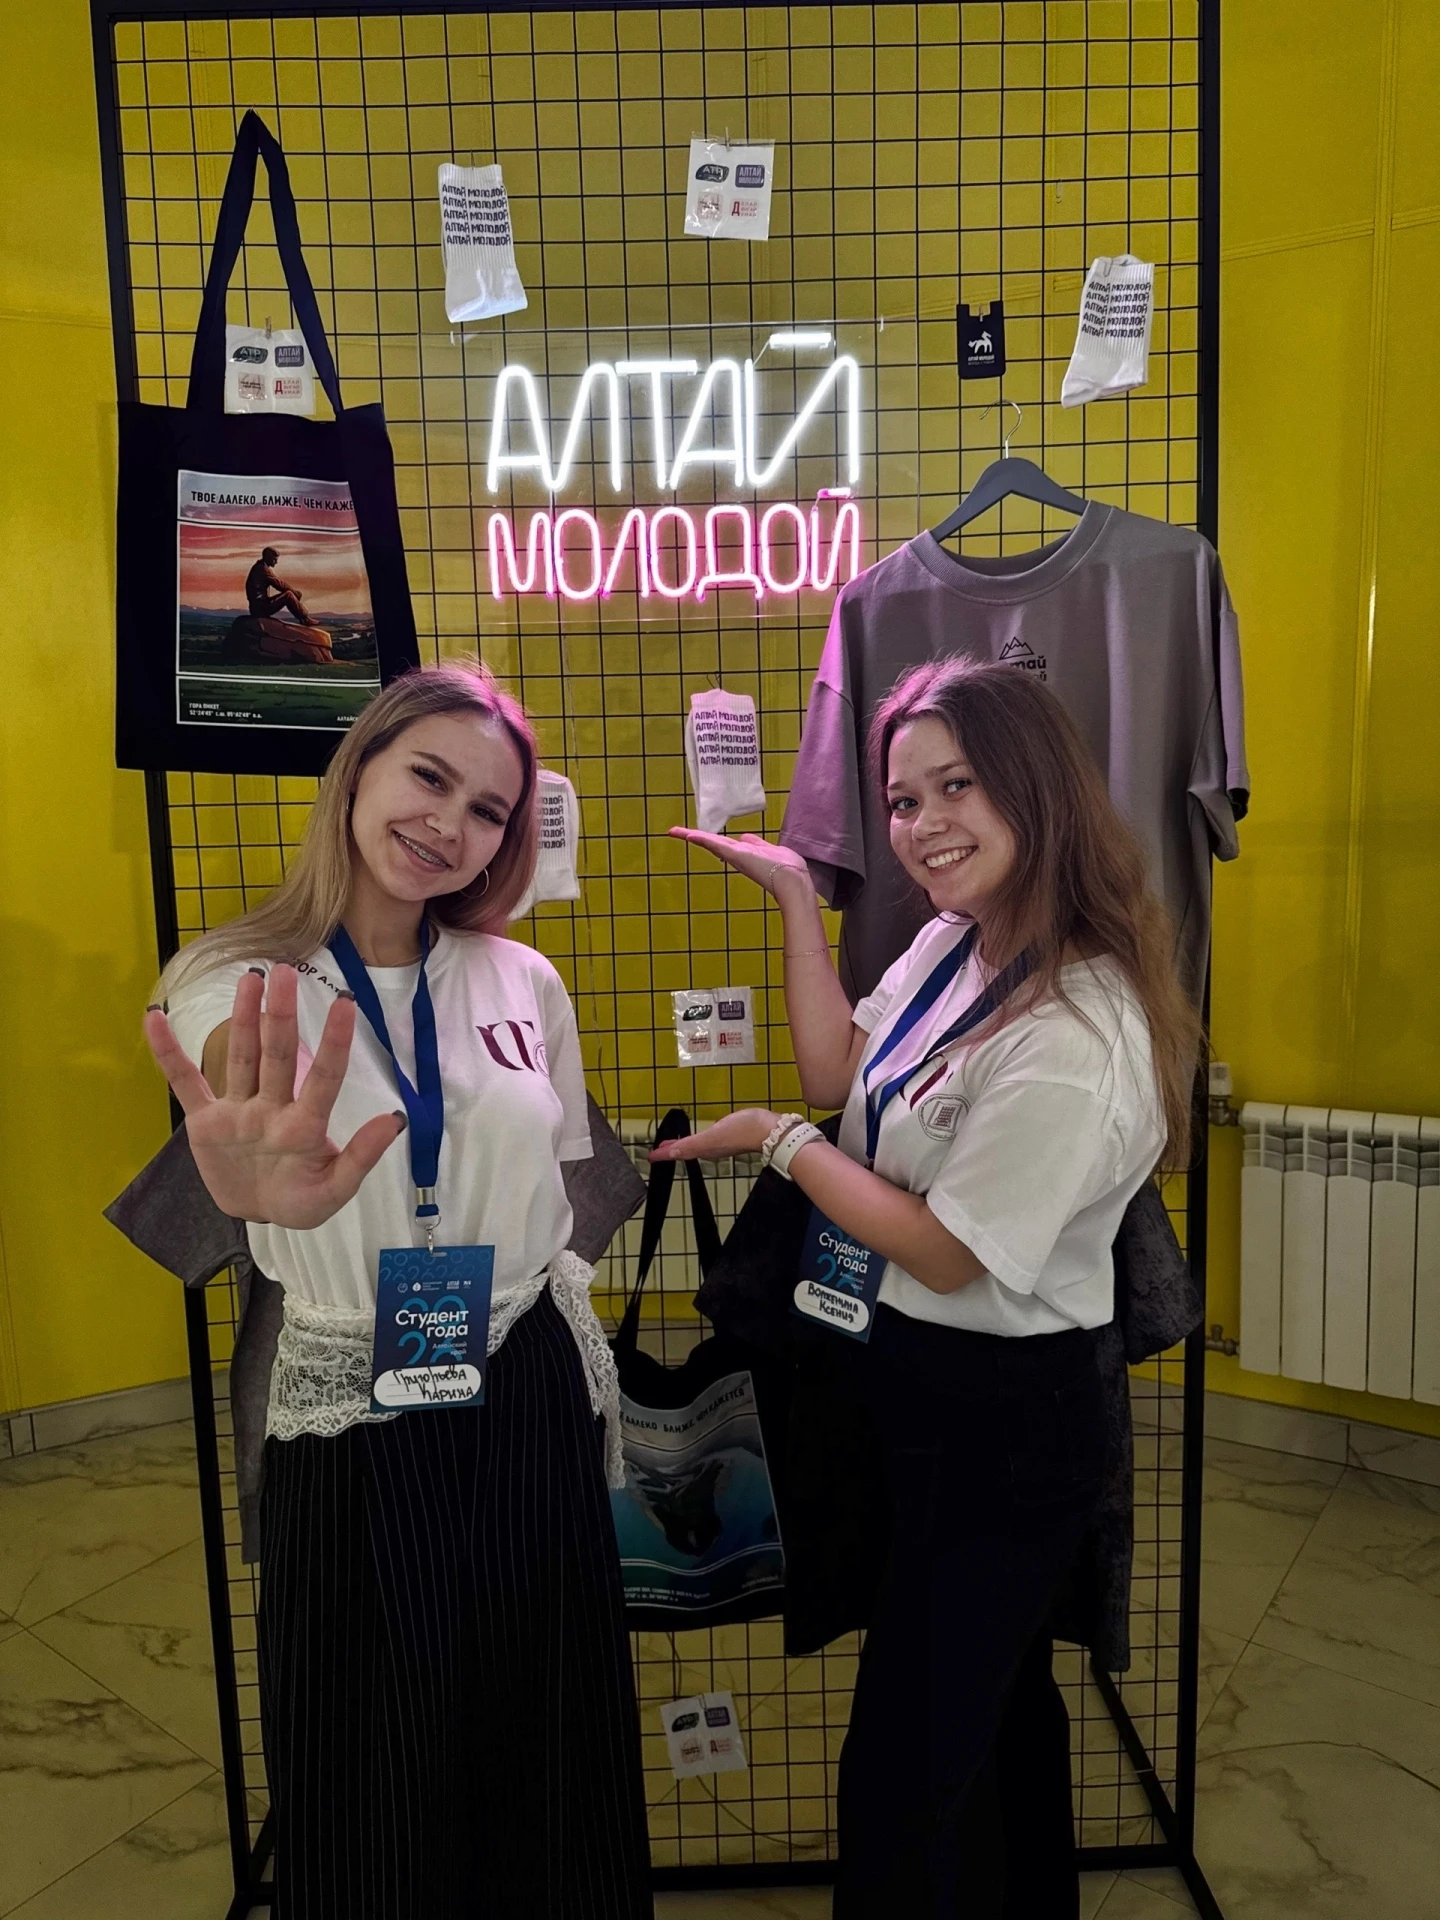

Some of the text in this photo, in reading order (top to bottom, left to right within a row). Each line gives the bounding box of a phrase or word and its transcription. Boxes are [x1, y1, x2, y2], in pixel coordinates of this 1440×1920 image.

[739, 166, 762, 176] АЛТАЙ
[442, 184, 506, 198] АЛТАЙ МОЛОДОЙ
[443, 196, 507, 209] АЛТАЙ МОЛОДОЙ
[444, 209, 508, 221] АЛТАЙ МОЛОДОЙ
[445, 222, 510, 233] АЛТАЙ МОЛОДОЙ
[447, 234, 511, 246] АЛТАЙ МОЛОДОЙ
[1089, 281, 1151, 292] АЛТАЙ МОЛОДОЙ
[1086, 291, 1149, 303] АЛТАЙ МОЛОДОЙ
[1085, 301, 1147, 315] АЛТАЙ МОЛОДОЙ
[1083, 312, 1146, 326] АЛТАЙ МОЛОДОЙ
[1081, 323, 1144, 337] АЛТАЙ МОЛОДОЙ
[278, 347, 300, 356] АЛТАЙ
[486, 331, 860, 493] АЛТАЙ
[191, 491, 216, 504] ТВОЕ
[218, 493, 256, 505] ДАЛЕКО
[304, 498, 323, 509] ЧЕМ
[325, 499, 354, 511] КАЖЕ
[487, 486, 860, 602] МОЛОДОЙ
[695, 710, 754, 722] АЛТАЙ МОЛОДОЙ
[696, 721, 755, 733] АЛТАЙ МОЛОДОЙ
[697, 732, 756, 743] АЛТАЙ МОЛОДОЙ
[699, 744, 757, 754] АЛТАЙ МОЛОДОЙ
[700, 756, 758, 766] АЛТАЙ МОЛОДОЙ
[819, 1232, 871, 1261] Студент
[837, 1255, 868, 1274] года
[395, 1309, 469, 1329] Студент
[427, 1324, 468, 1338] года
[625, 1415, 657, 1430] ДАЛЕКО
[709, 1388, 744, 1413] КАЖЕТСЯ
